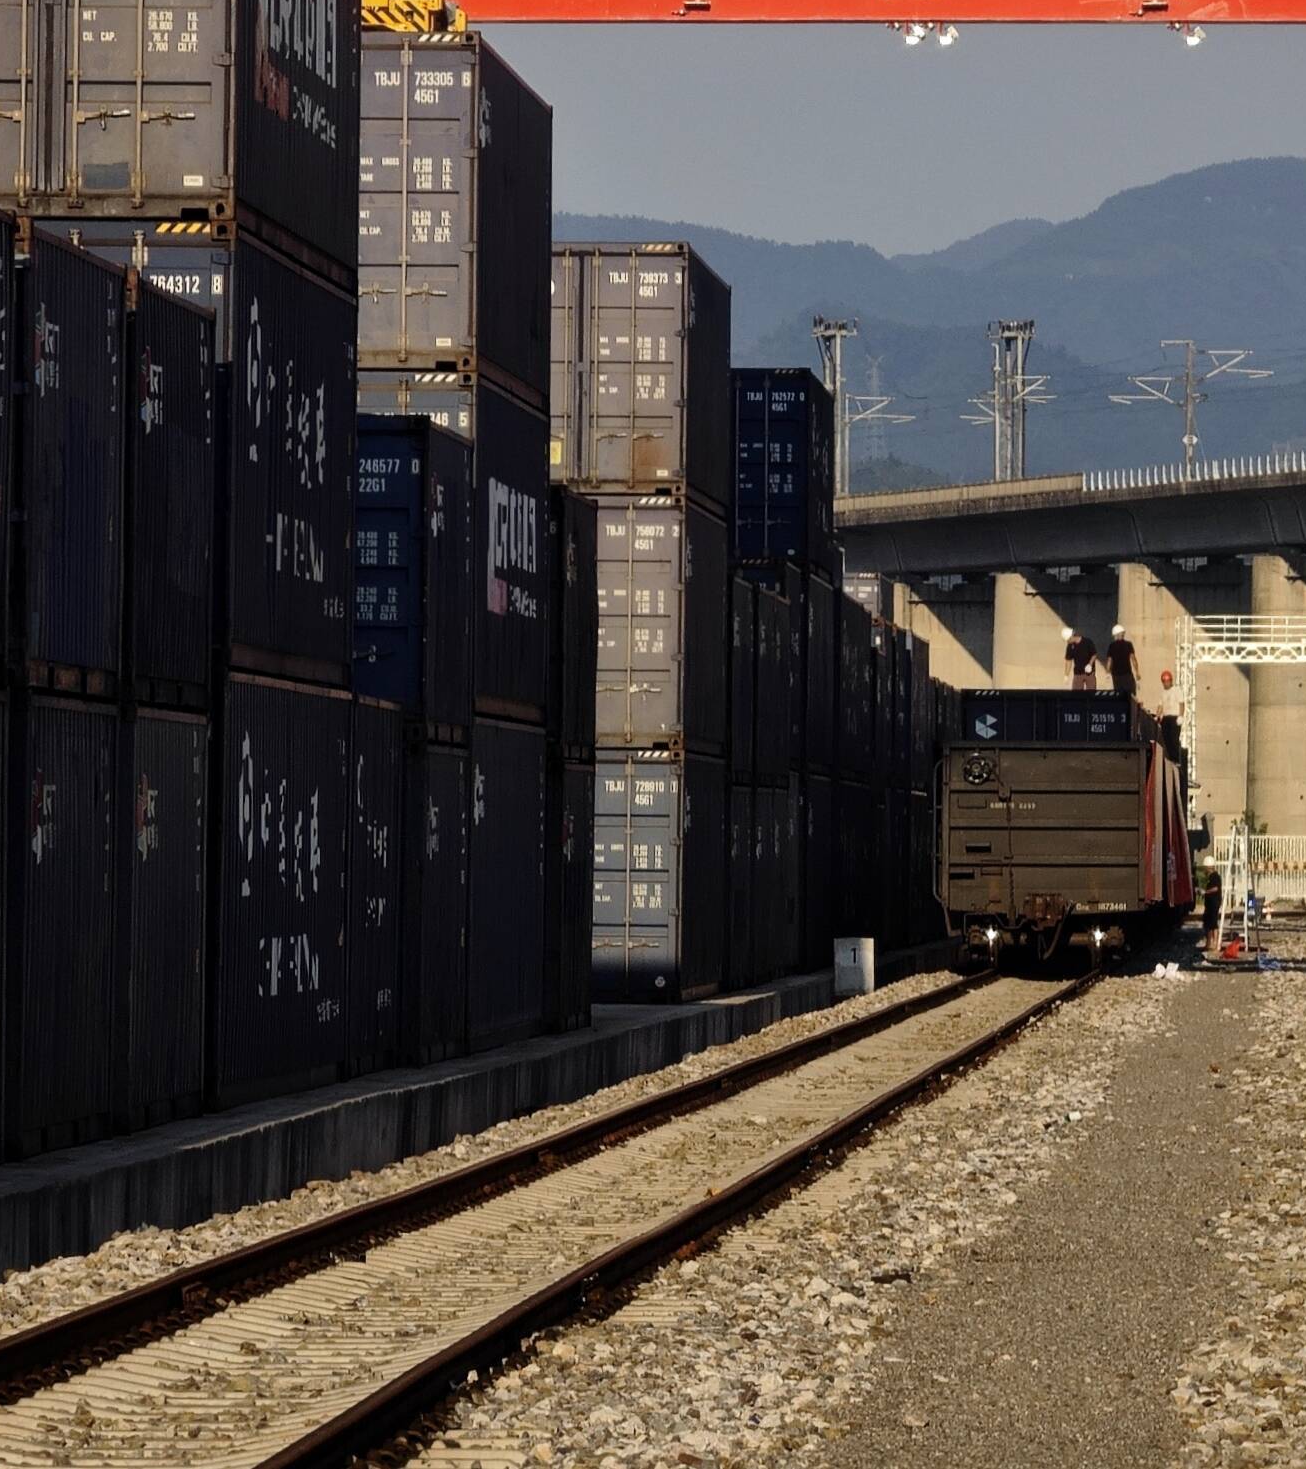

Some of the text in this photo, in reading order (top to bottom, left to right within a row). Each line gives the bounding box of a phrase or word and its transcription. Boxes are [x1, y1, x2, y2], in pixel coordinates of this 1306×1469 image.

[375, 72, 401, 86] TBJU
[414, 72, 453, 86] 733305
[212, 275, 223, 293] 8
[359, 478, 386, 492] 22G1
[605, 780, 625, 792] TBJU
[850, 947, 857, 964] 1
